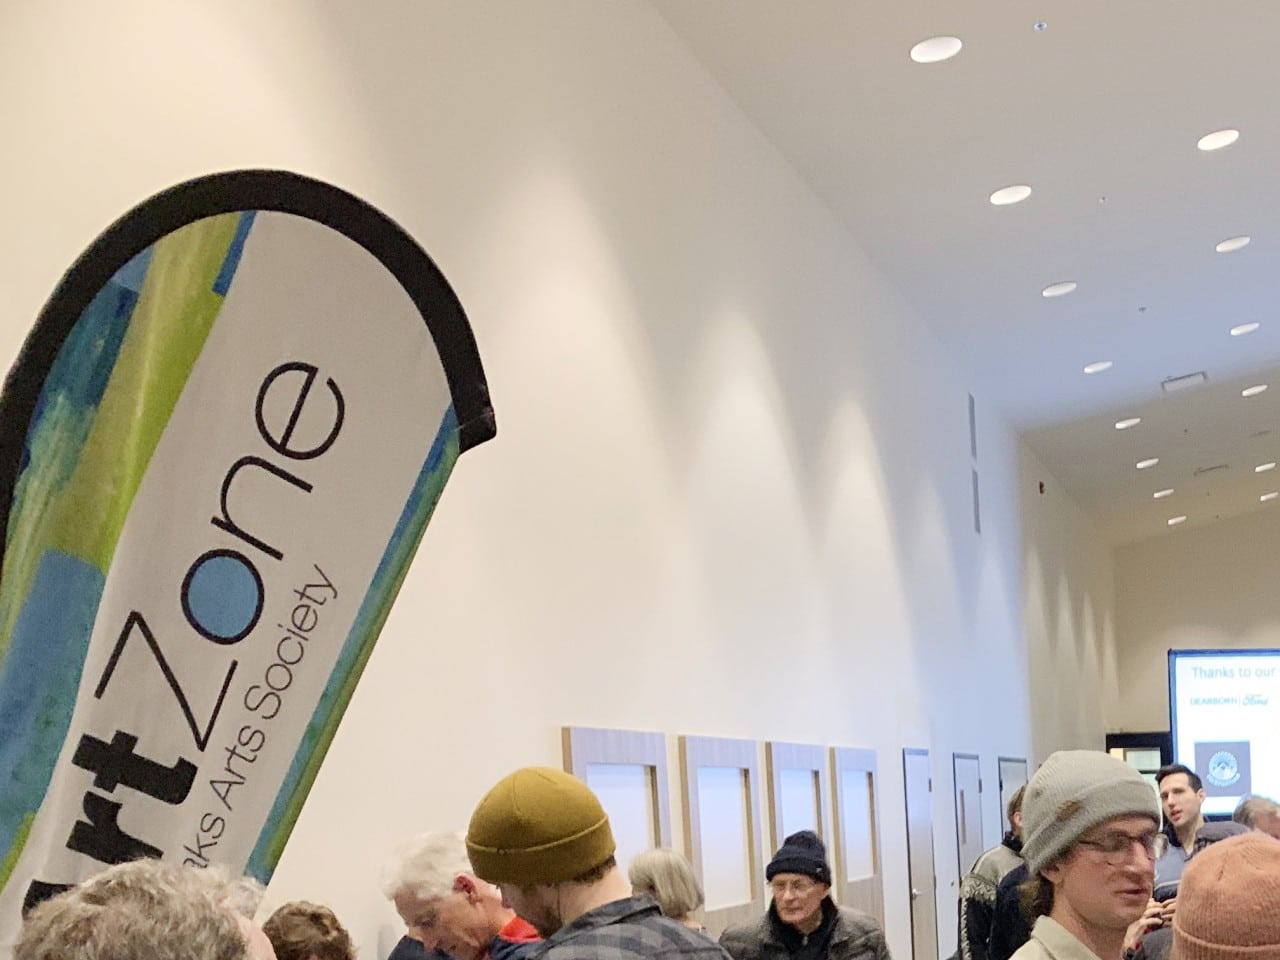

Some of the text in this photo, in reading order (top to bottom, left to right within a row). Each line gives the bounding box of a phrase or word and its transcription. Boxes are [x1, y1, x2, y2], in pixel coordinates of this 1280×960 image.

[22, 361, 345, 921] rtZone
[209, 724, 267, 811] Arts
[244, 562, 339, 720] Society
[1192, 666, 1235, 679] Thanks
[1238, 666, 1251, 678] to
[1255, 667, 1276, 678] our
